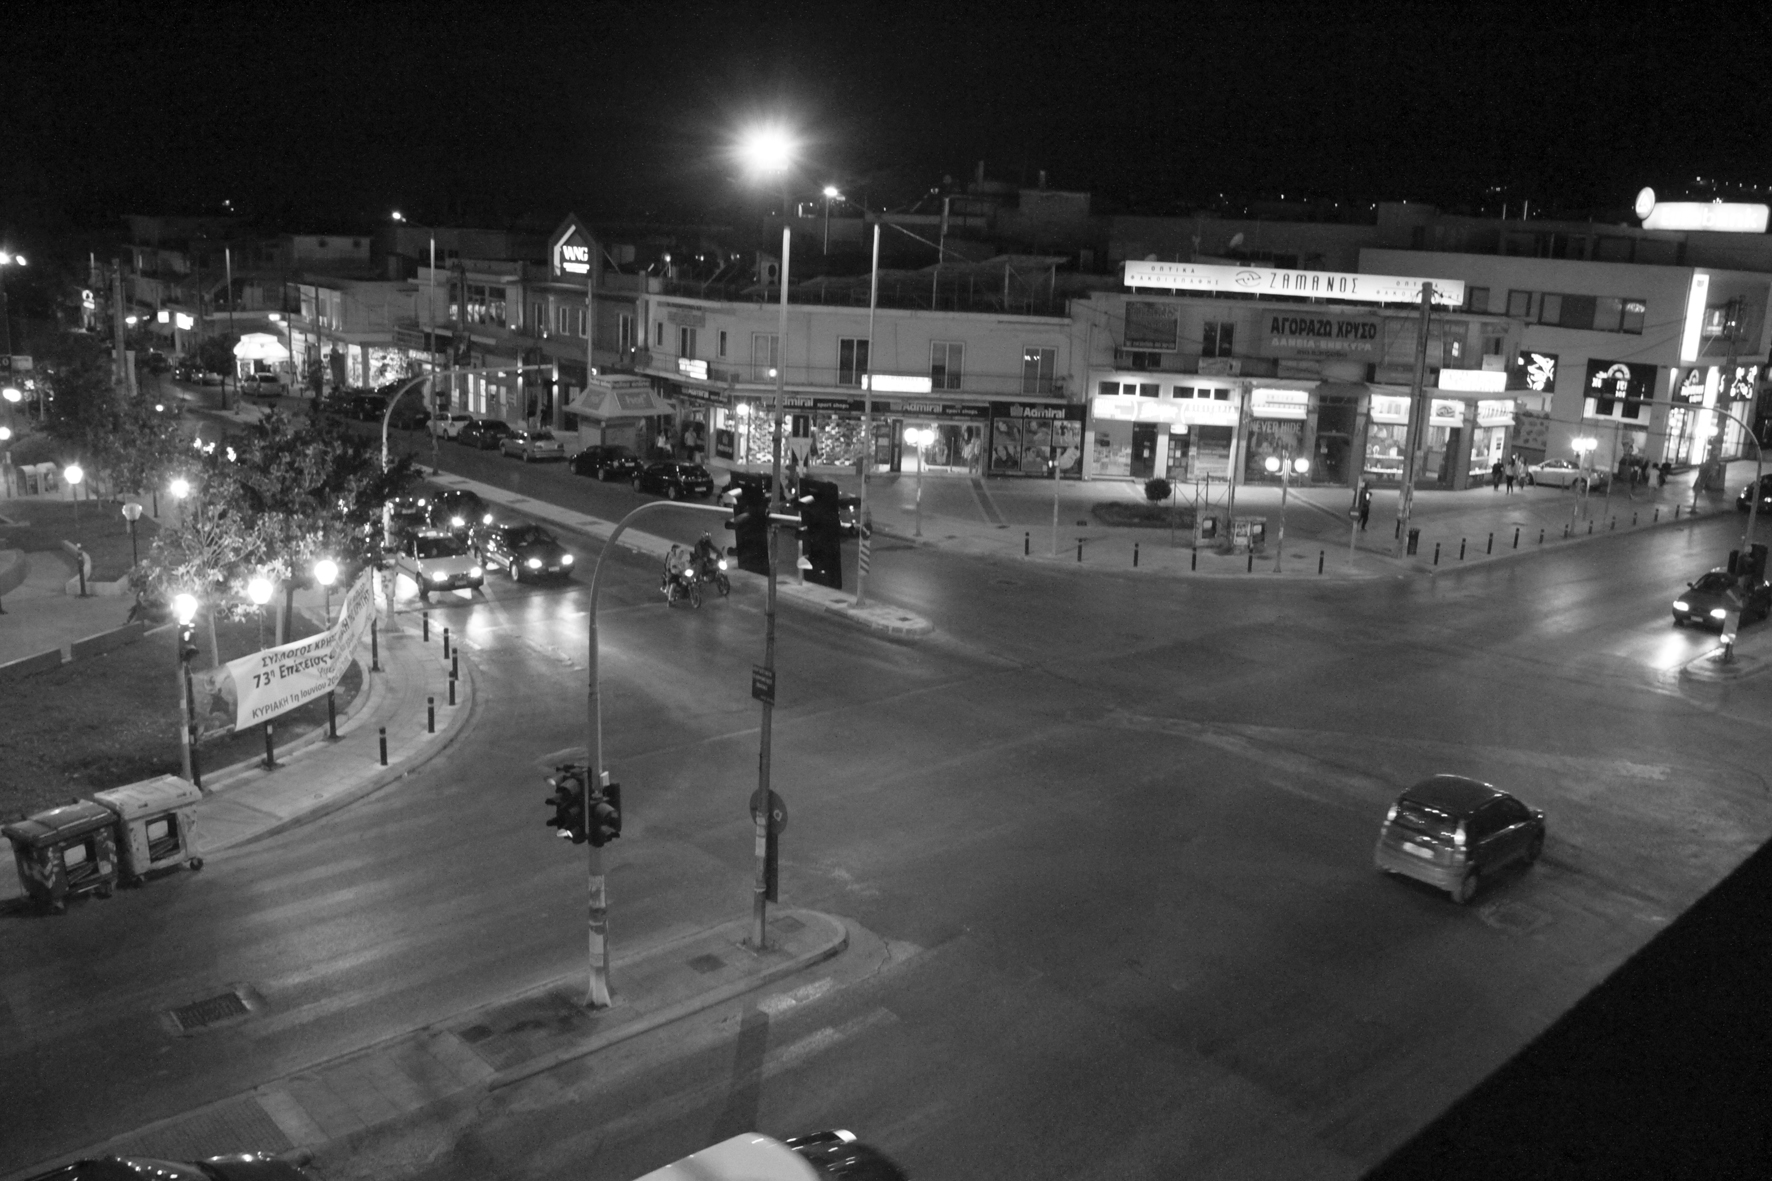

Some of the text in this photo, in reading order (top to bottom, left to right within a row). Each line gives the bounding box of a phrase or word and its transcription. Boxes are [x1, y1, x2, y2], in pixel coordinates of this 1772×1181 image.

[1269, 272, 1358, 294] ΖΑΜΑΝΟΣ
[1270, 316, 1377, 341] ΑΓΟΡΑΖΩ ΧΡΥΣΟ
[1022, 406, 1066, 420] Admiral
[1249, 421, 1302, 434] NEVER HIDE
[261, 643, 312, 668] ΣΥΛΛΟΓΟΣ
[252, 697, 289, 719] ΚΥΡΙΑΚΗ
[290, 693, 300, 708] 1η
[300, 682, 327, 699] Ιουνίου
